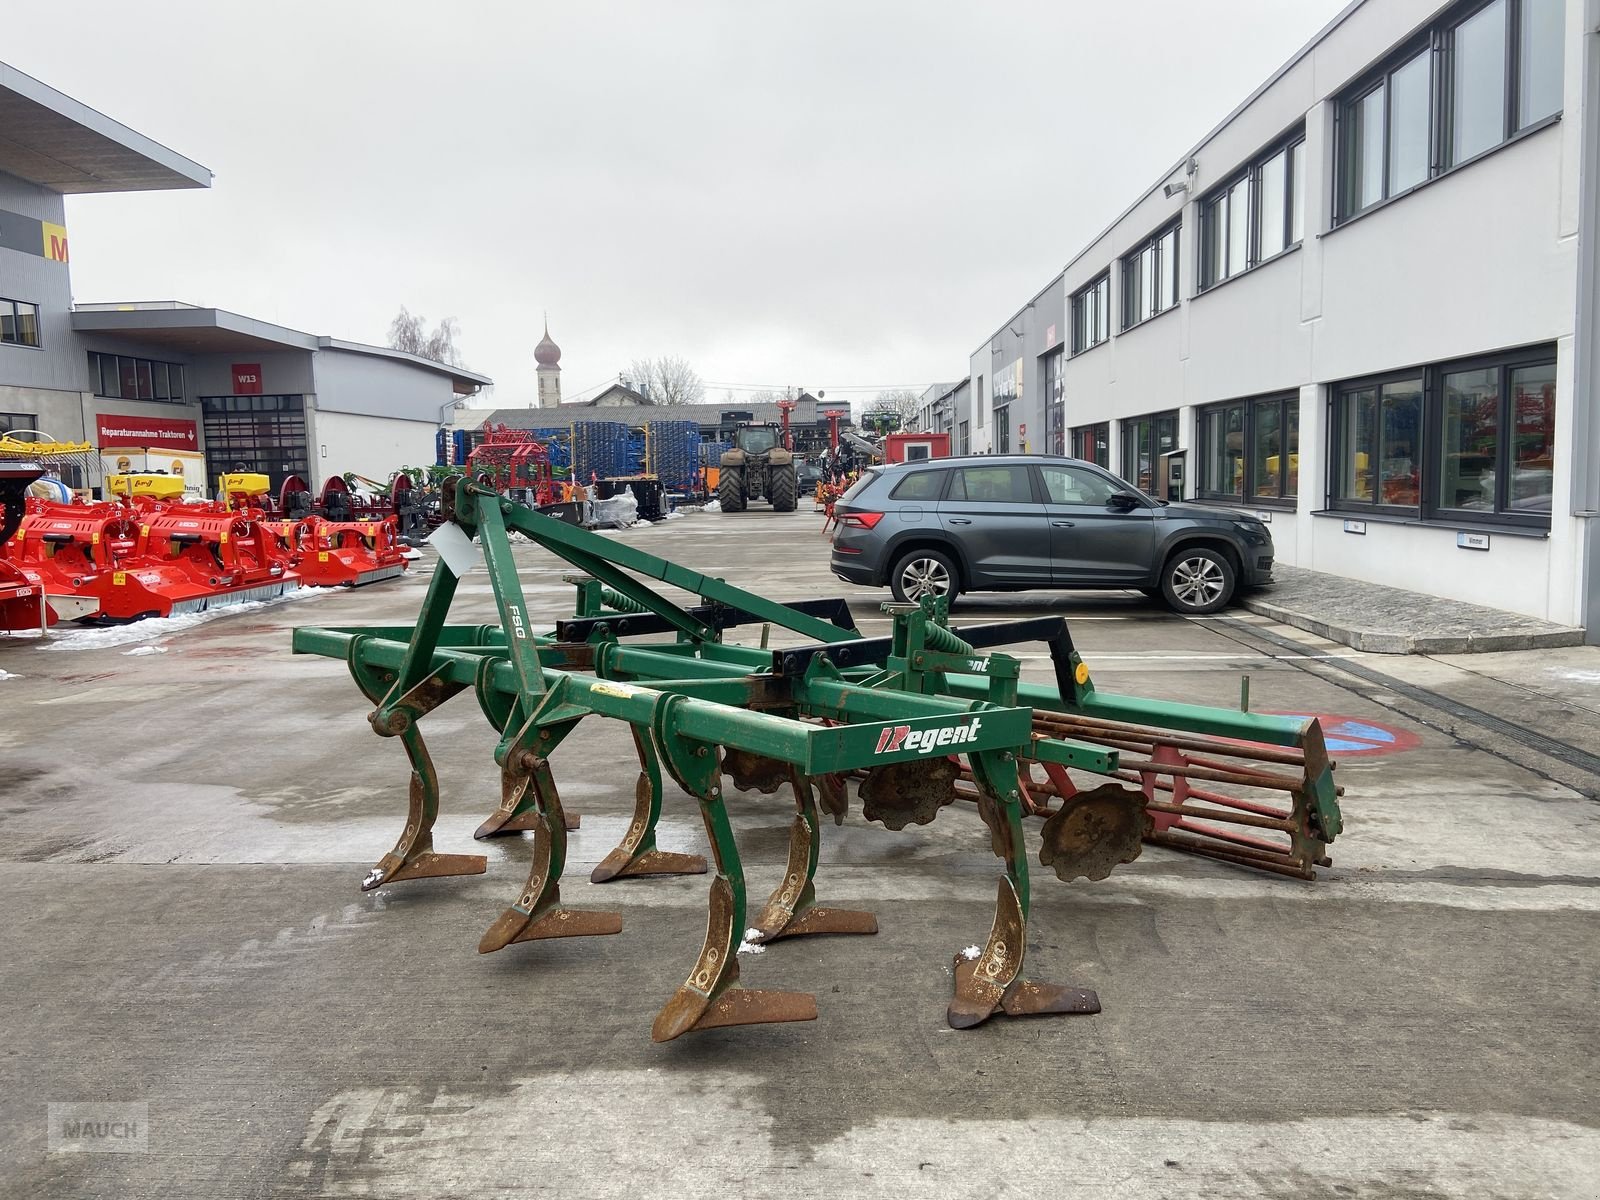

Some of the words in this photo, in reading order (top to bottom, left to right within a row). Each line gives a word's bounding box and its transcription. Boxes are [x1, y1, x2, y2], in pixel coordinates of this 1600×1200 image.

[238, 375, 257, 383] W13
[101, 427, 158, 438] Reparaturannahme
[158, 430, 186, 439] Traktoren
[874, 717, 982, 754] Regent
